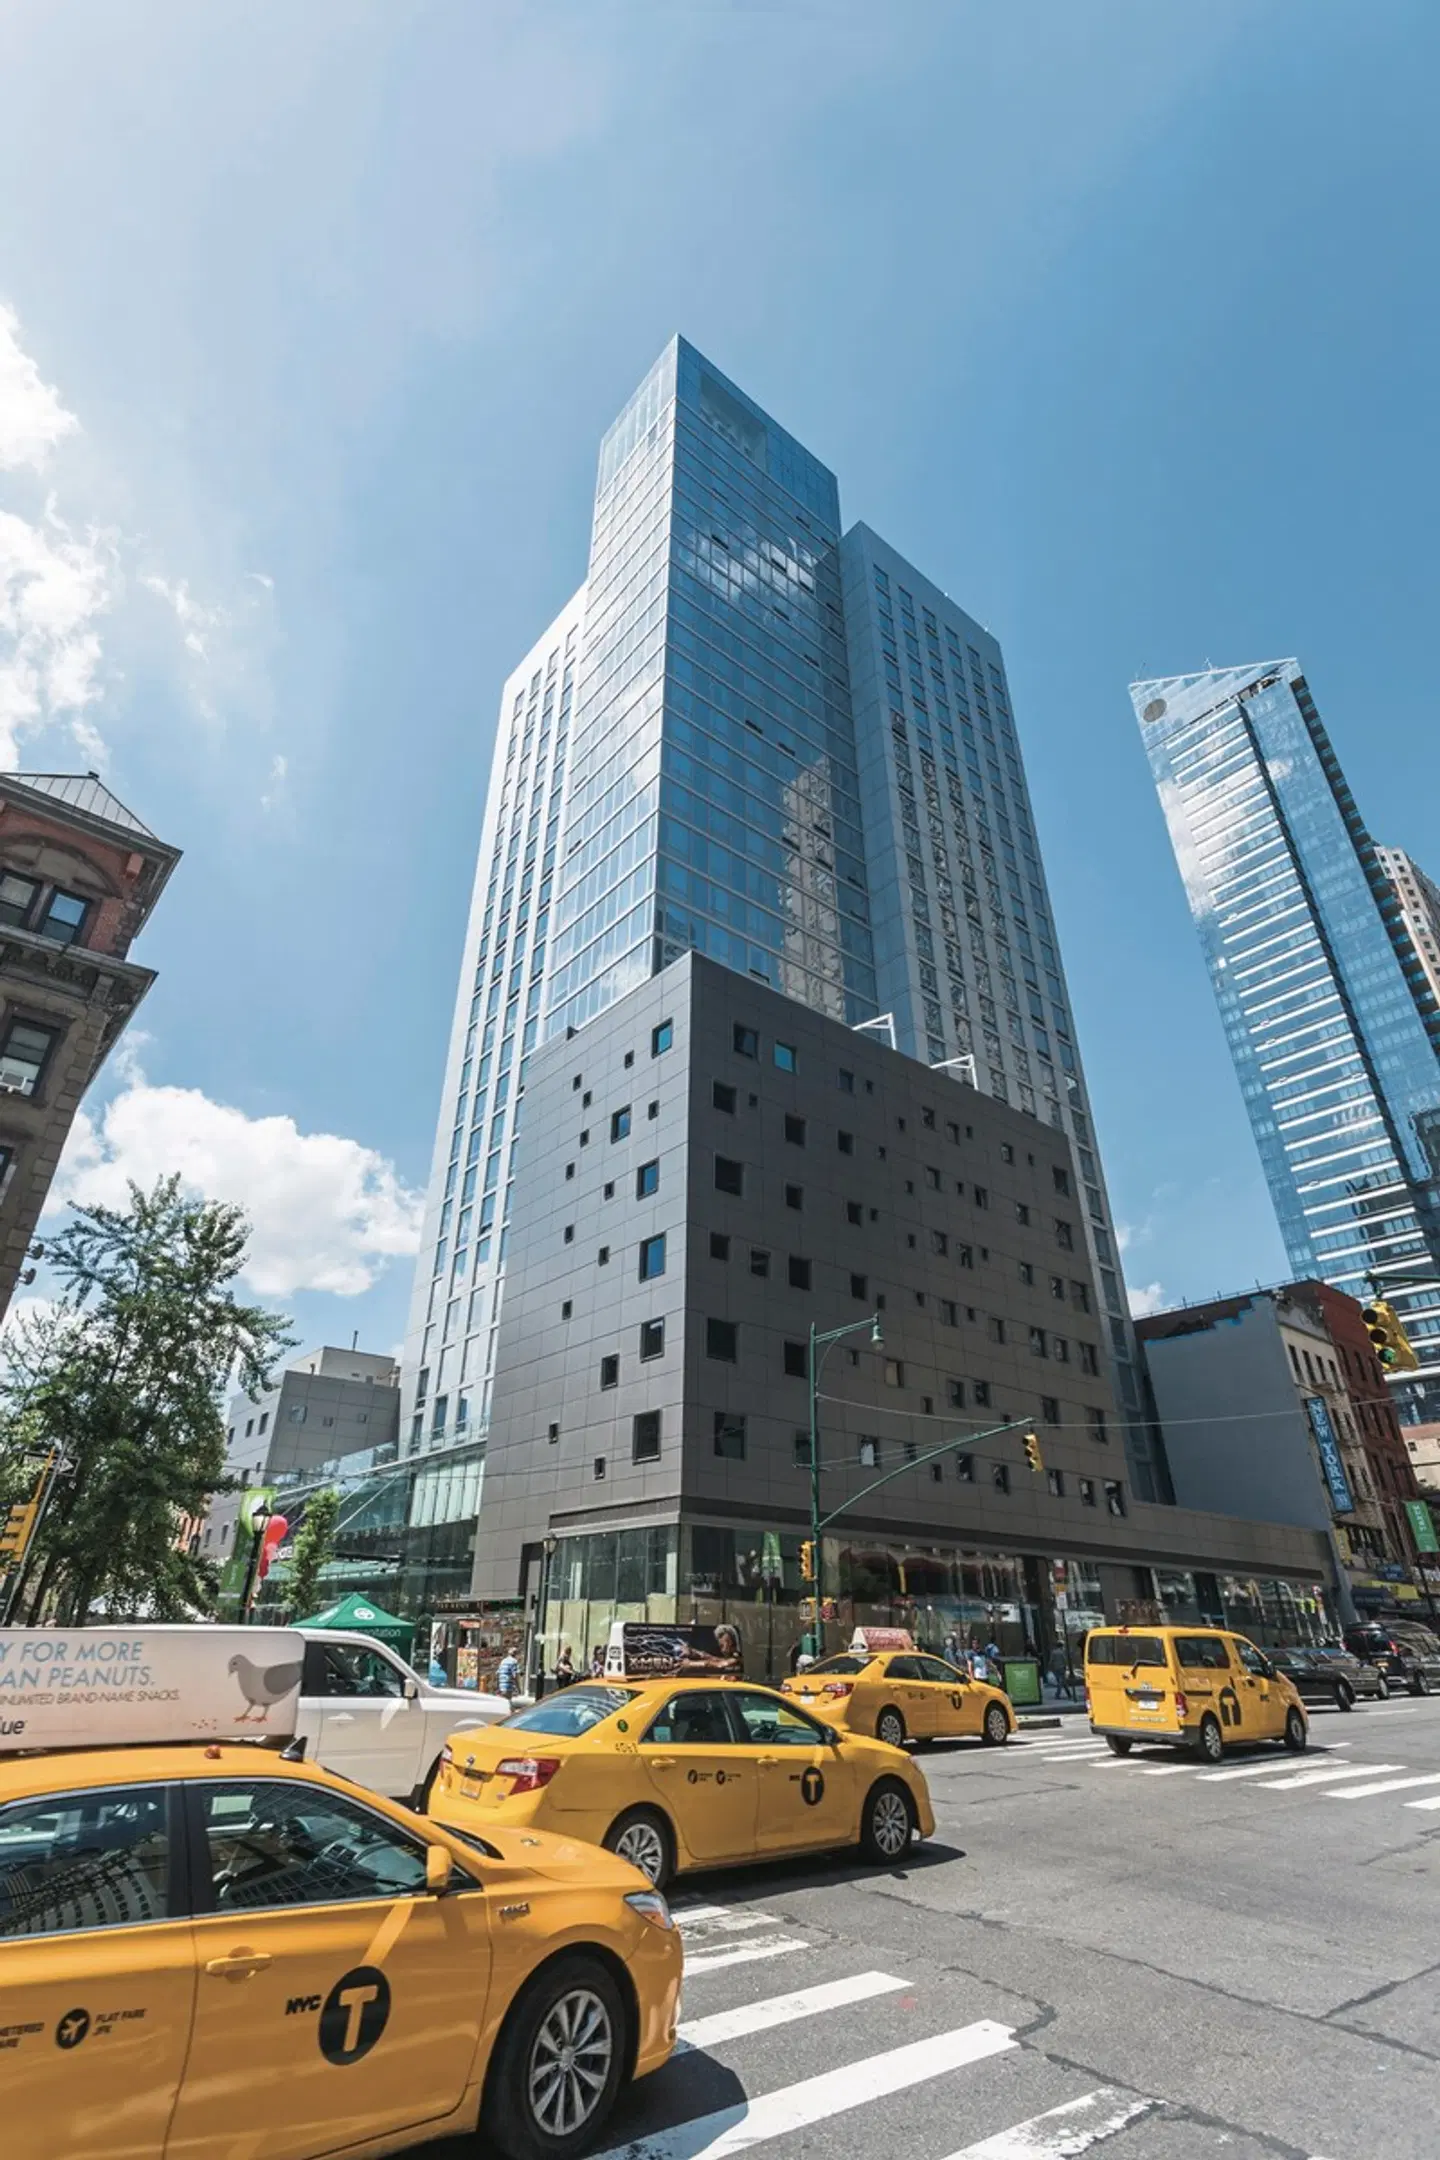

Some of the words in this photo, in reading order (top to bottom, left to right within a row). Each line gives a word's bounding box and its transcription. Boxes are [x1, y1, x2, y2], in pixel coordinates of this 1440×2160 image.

[1310, 1402, 1329, 1438] NEW
[1322, 1442, 1344, 1490] YORK
[19, 1641, 68, 1663] FOR
[74, 1641, 143, 1661] MORE
[0, 1667, 40, 1688] AN
[47, 1665, 156, 1688] PEANUTS.
[285, 1995, 321, 2015] NYC
